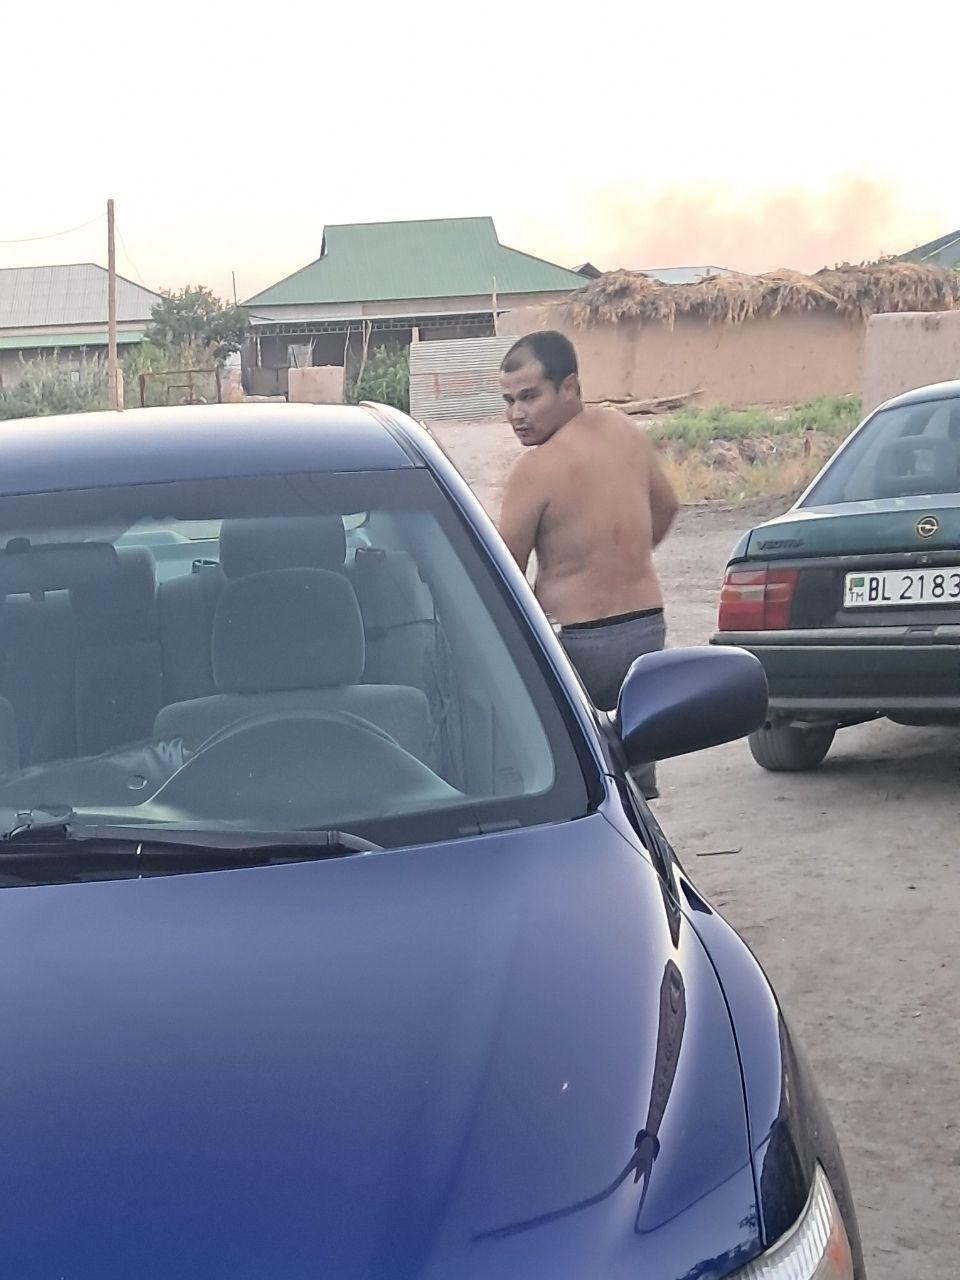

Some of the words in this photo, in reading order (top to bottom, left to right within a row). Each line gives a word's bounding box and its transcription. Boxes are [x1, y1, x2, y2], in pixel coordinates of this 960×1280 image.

[849, 591, 864, 602] TM
[868, 577, 891, 602] BL
[899, 573, 960, 600] 2183
